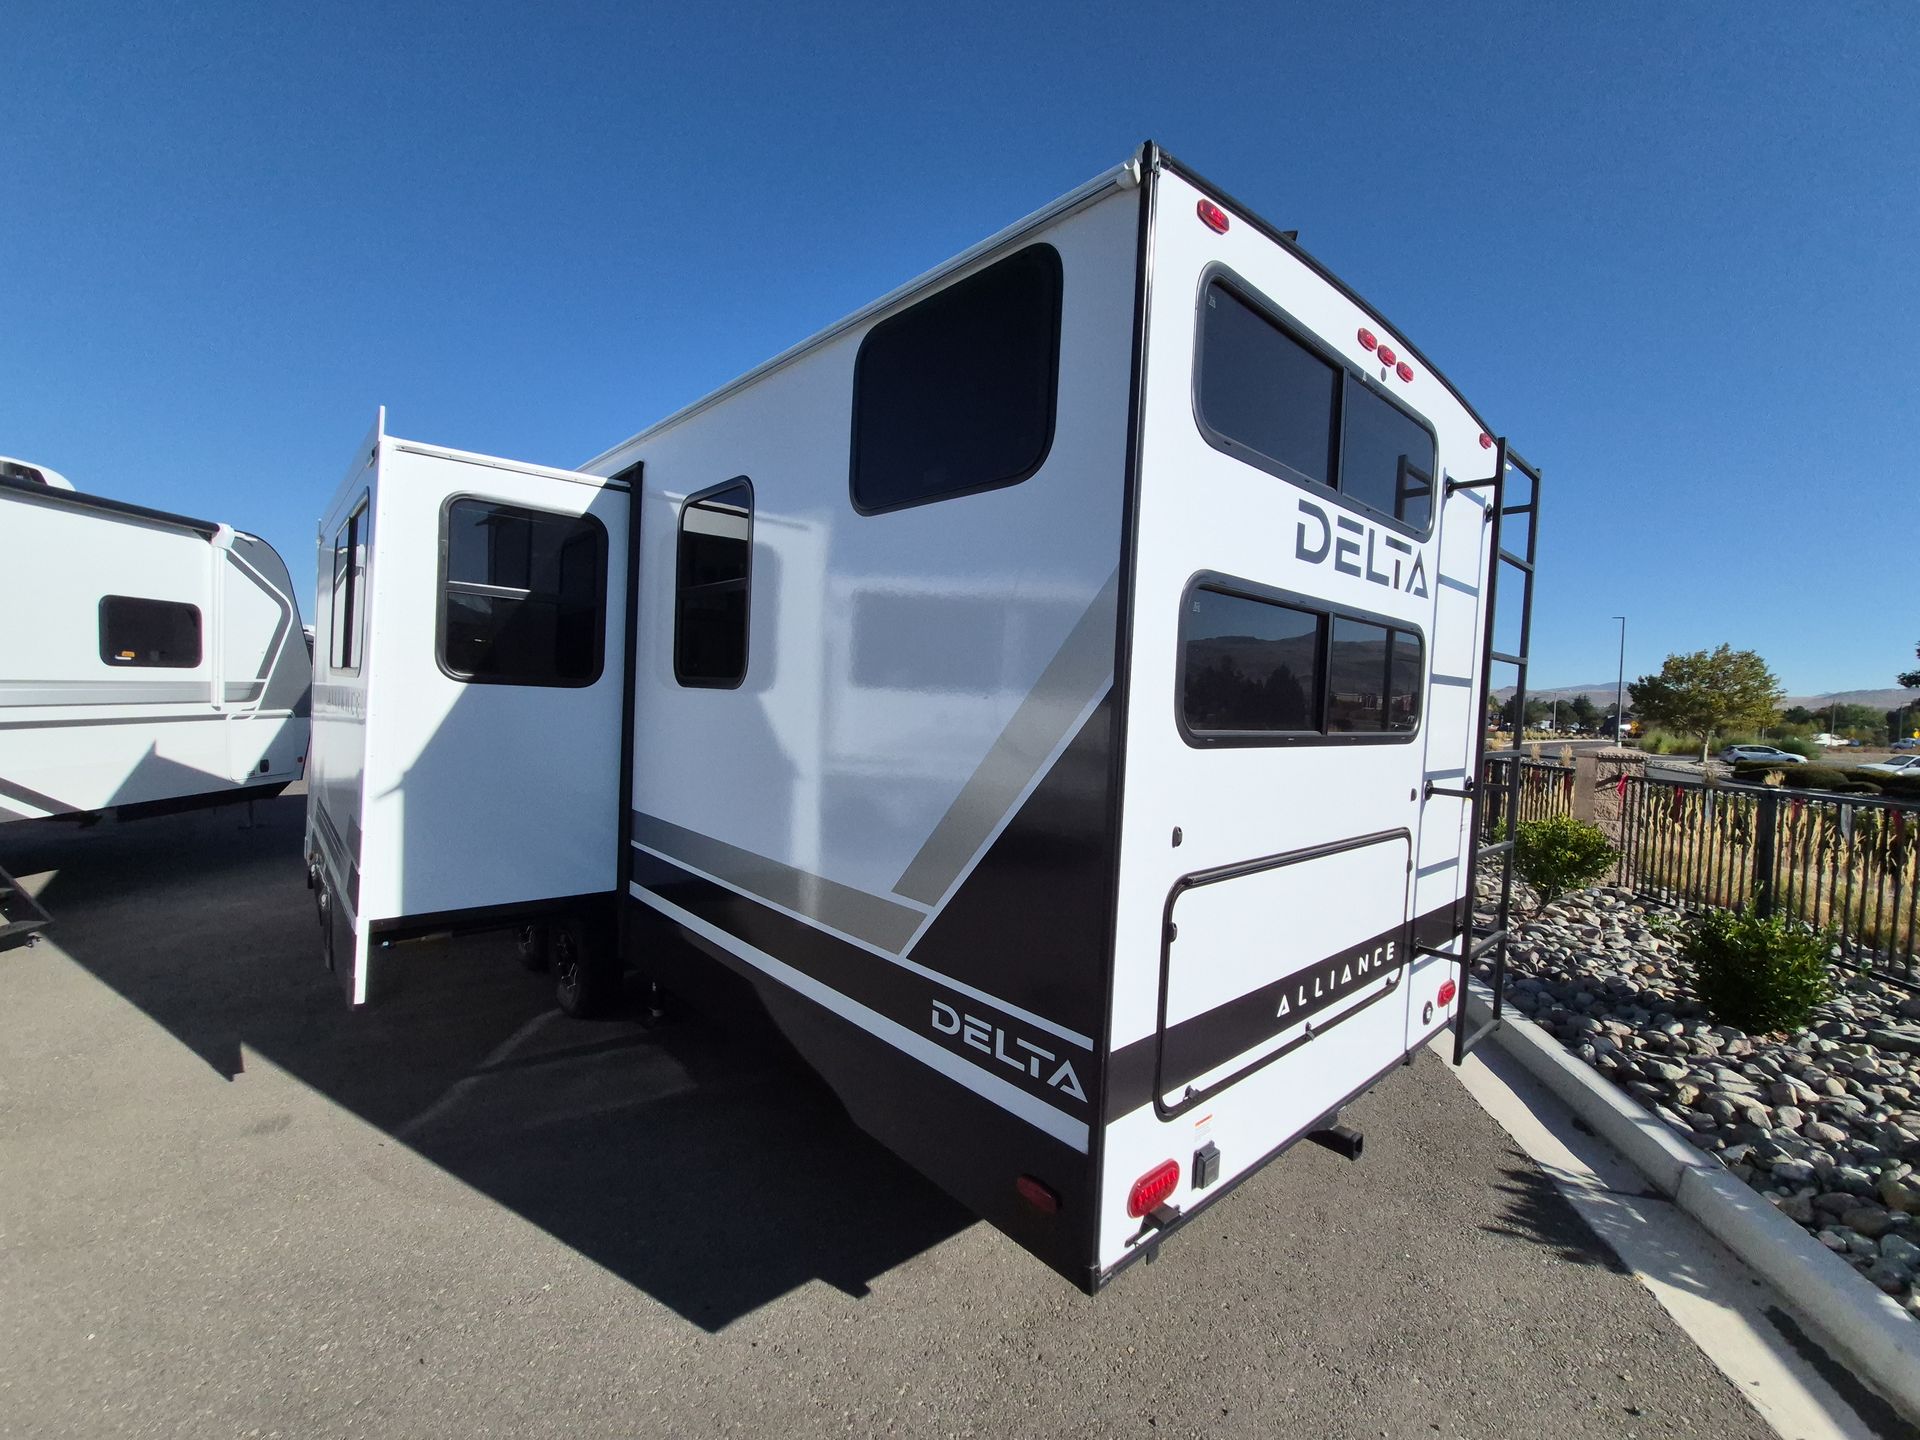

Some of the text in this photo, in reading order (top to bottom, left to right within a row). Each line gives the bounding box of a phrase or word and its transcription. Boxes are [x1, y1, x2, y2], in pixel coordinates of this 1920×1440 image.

[1295, 498, 1429, 600] DELTA
[1276, 941, 1396, 1018] ALLIANCE
[931, 999, 1089, 1104] DELTA
